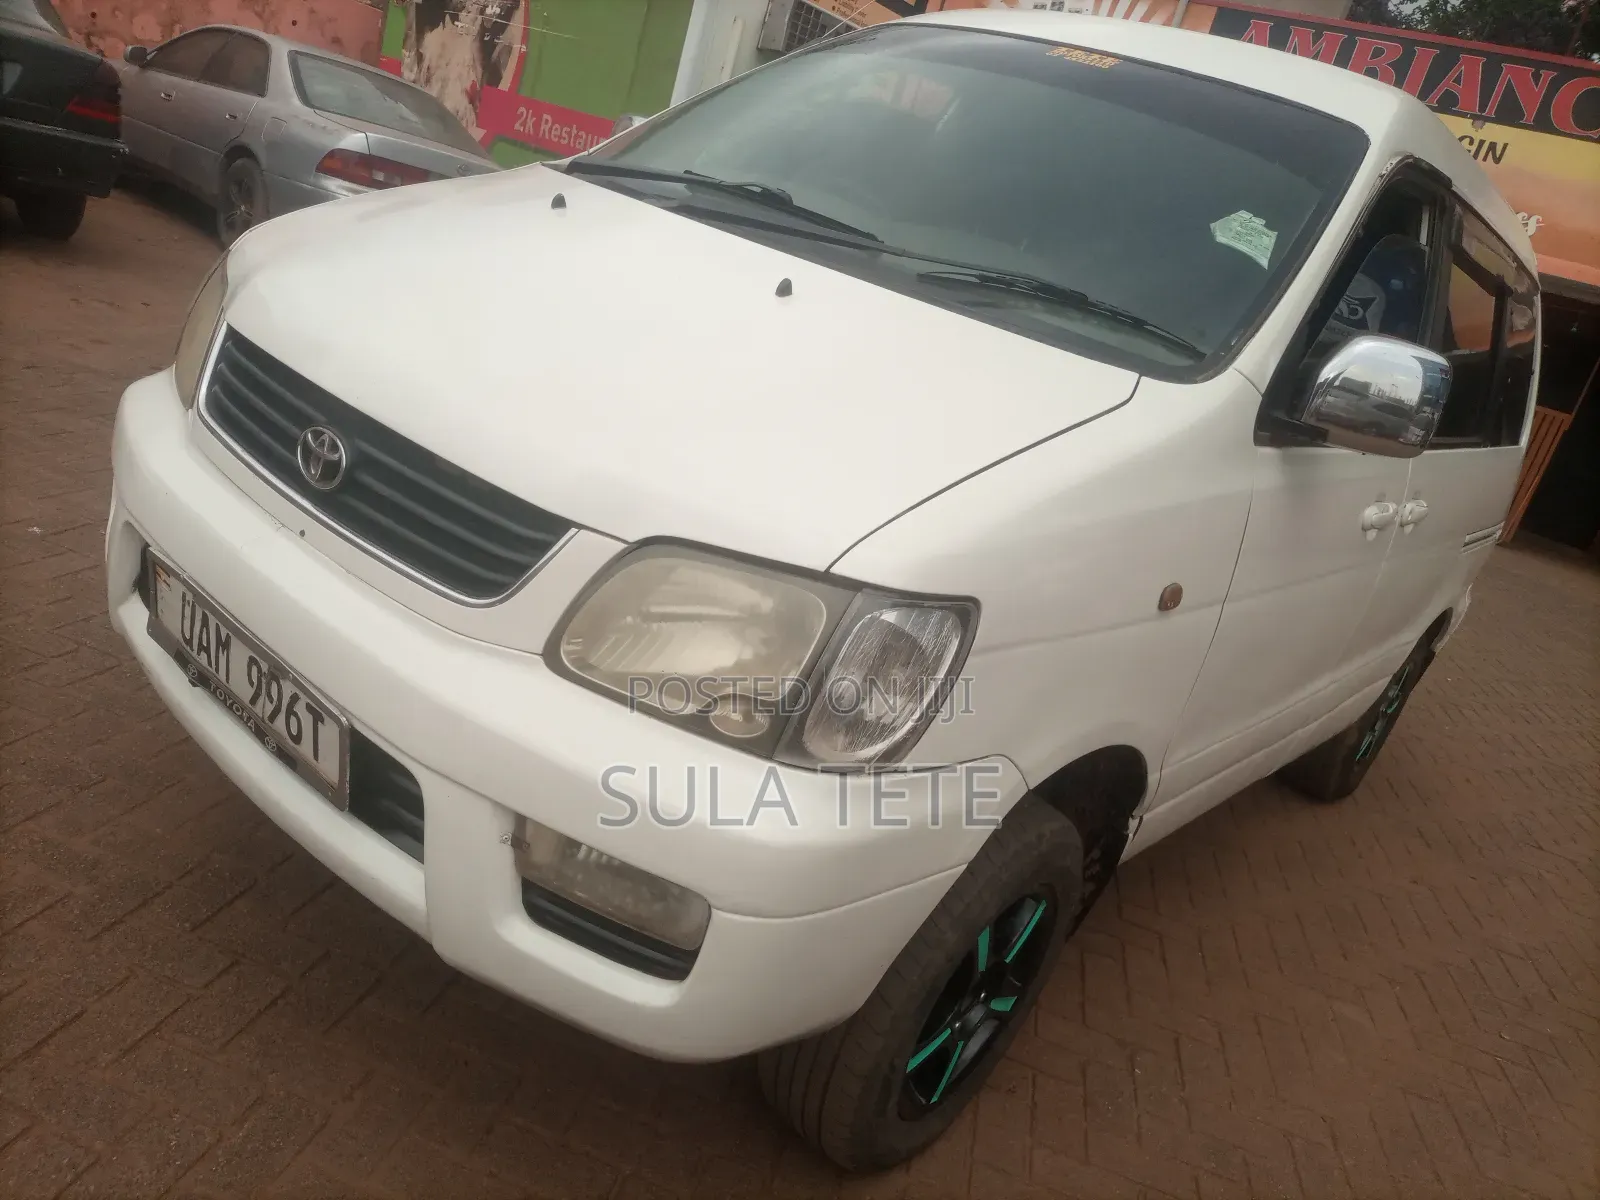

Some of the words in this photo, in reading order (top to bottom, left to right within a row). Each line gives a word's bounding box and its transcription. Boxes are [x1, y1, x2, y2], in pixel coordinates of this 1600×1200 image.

[514, 106, 536, 135] 2k
[180, 590, 232, 685] UAM
[246, 654, 325, 763] 996T
[208, 680, 256, 733] TOYOTA
